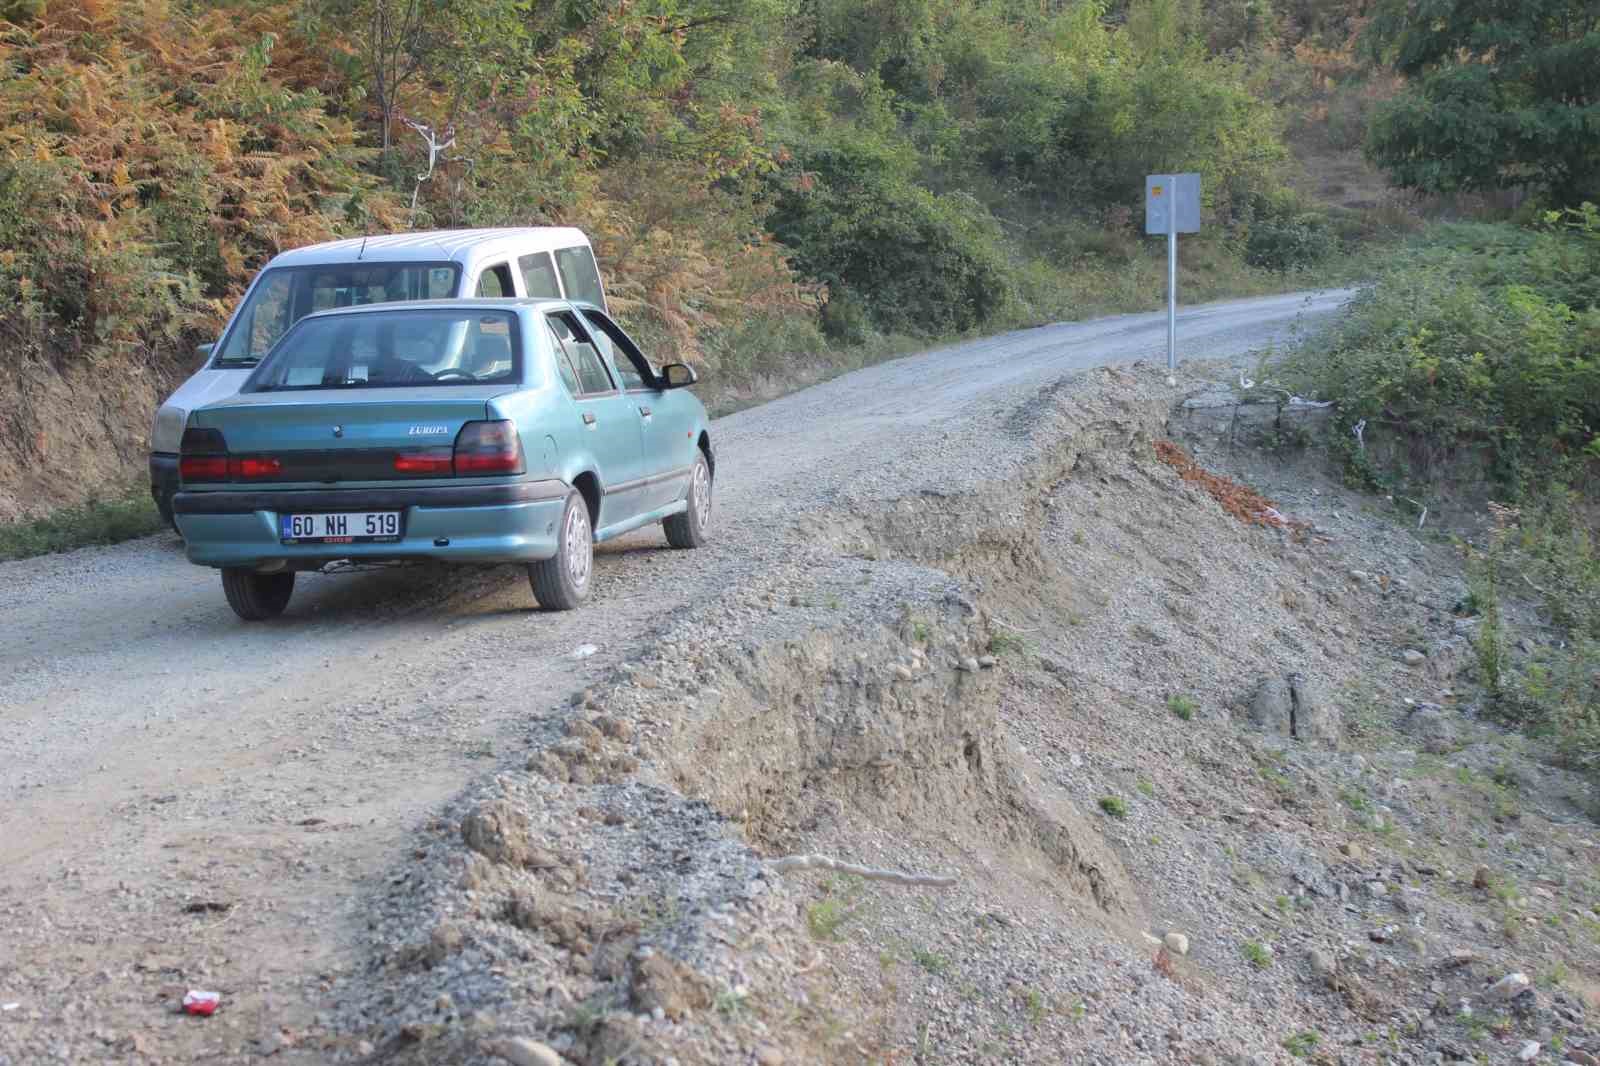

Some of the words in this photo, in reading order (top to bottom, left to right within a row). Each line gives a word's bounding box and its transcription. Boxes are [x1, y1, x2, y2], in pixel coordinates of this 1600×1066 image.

[408, 426, 449, 435] EUROPA
[292, 516, 314, 536] 60
[326, 515, 347, 535] NH
[366, 514, 397, 534] 519
